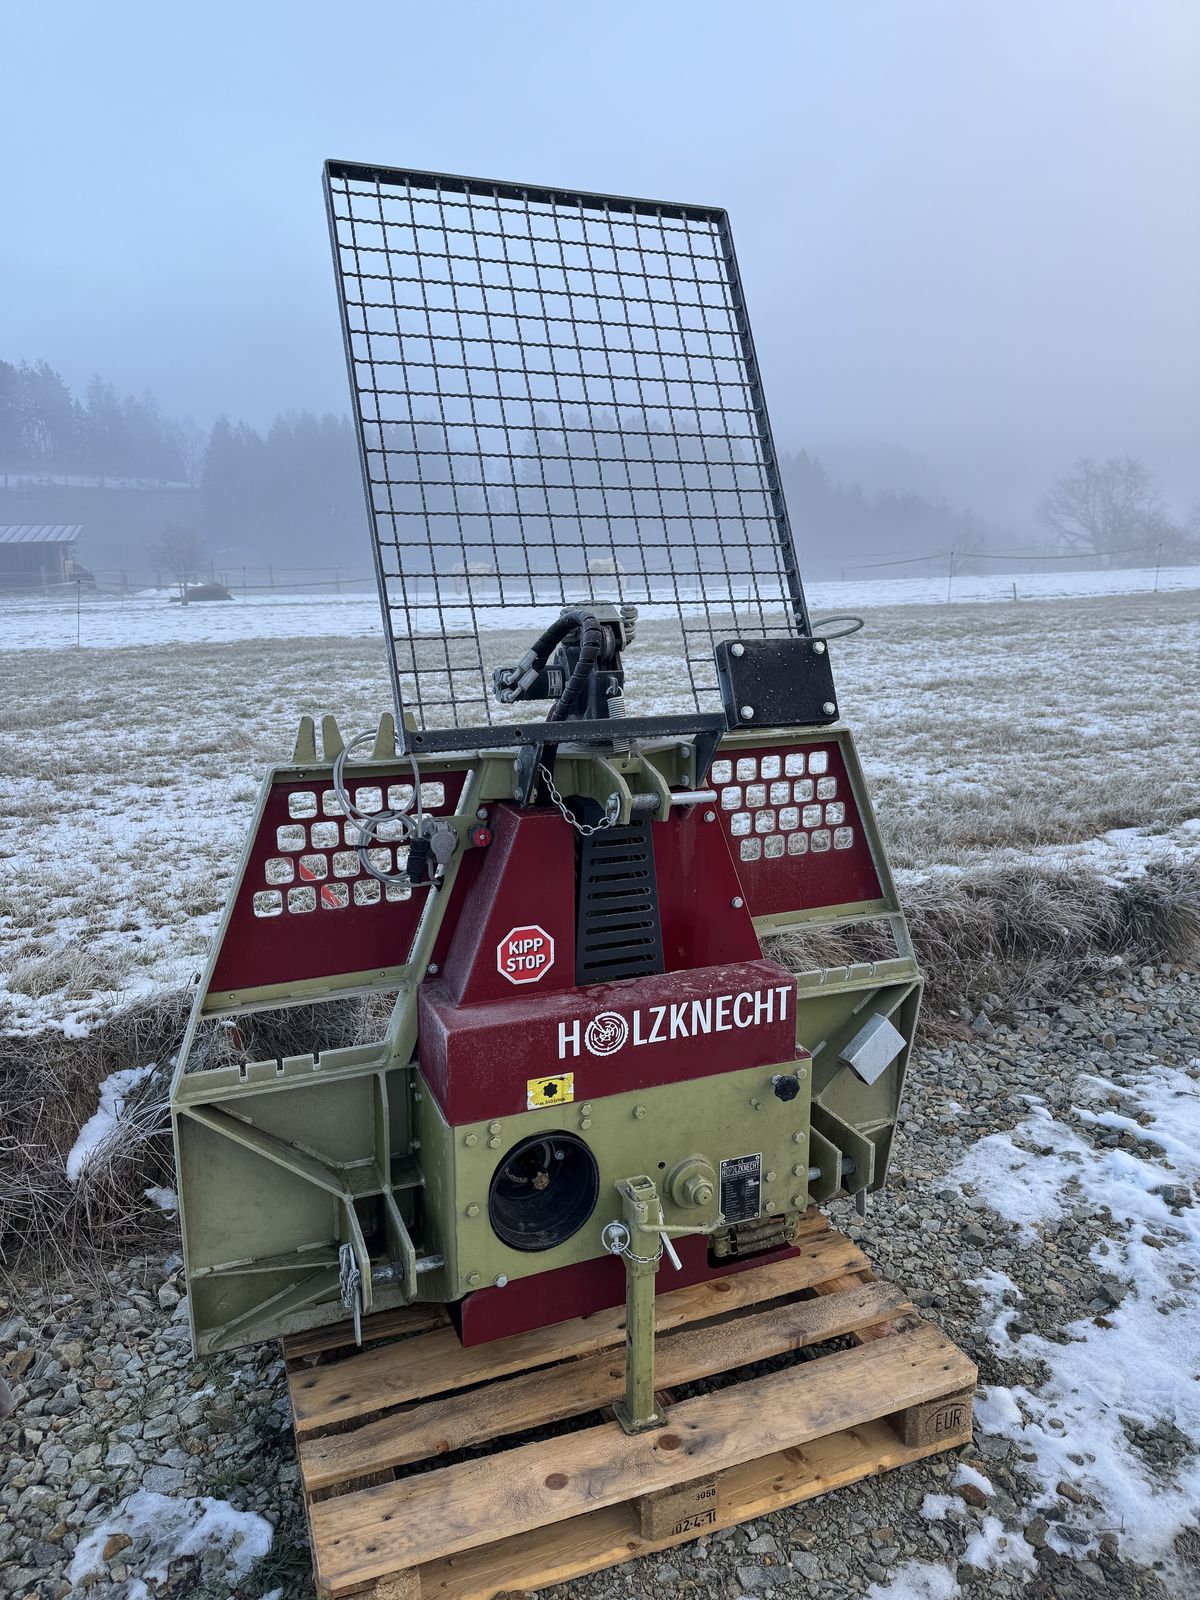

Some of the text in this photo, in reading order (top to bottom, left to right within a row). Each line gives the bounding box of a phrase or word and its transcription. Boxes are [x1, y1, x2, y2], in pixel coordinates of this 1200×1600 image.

[508, 937, 543, 955] KIPP
[506, 953, 546, 973] STOP
[558, 986, 792, 1059] HOLZKNECHT
[935, 1408, 962, 1433] EUR
